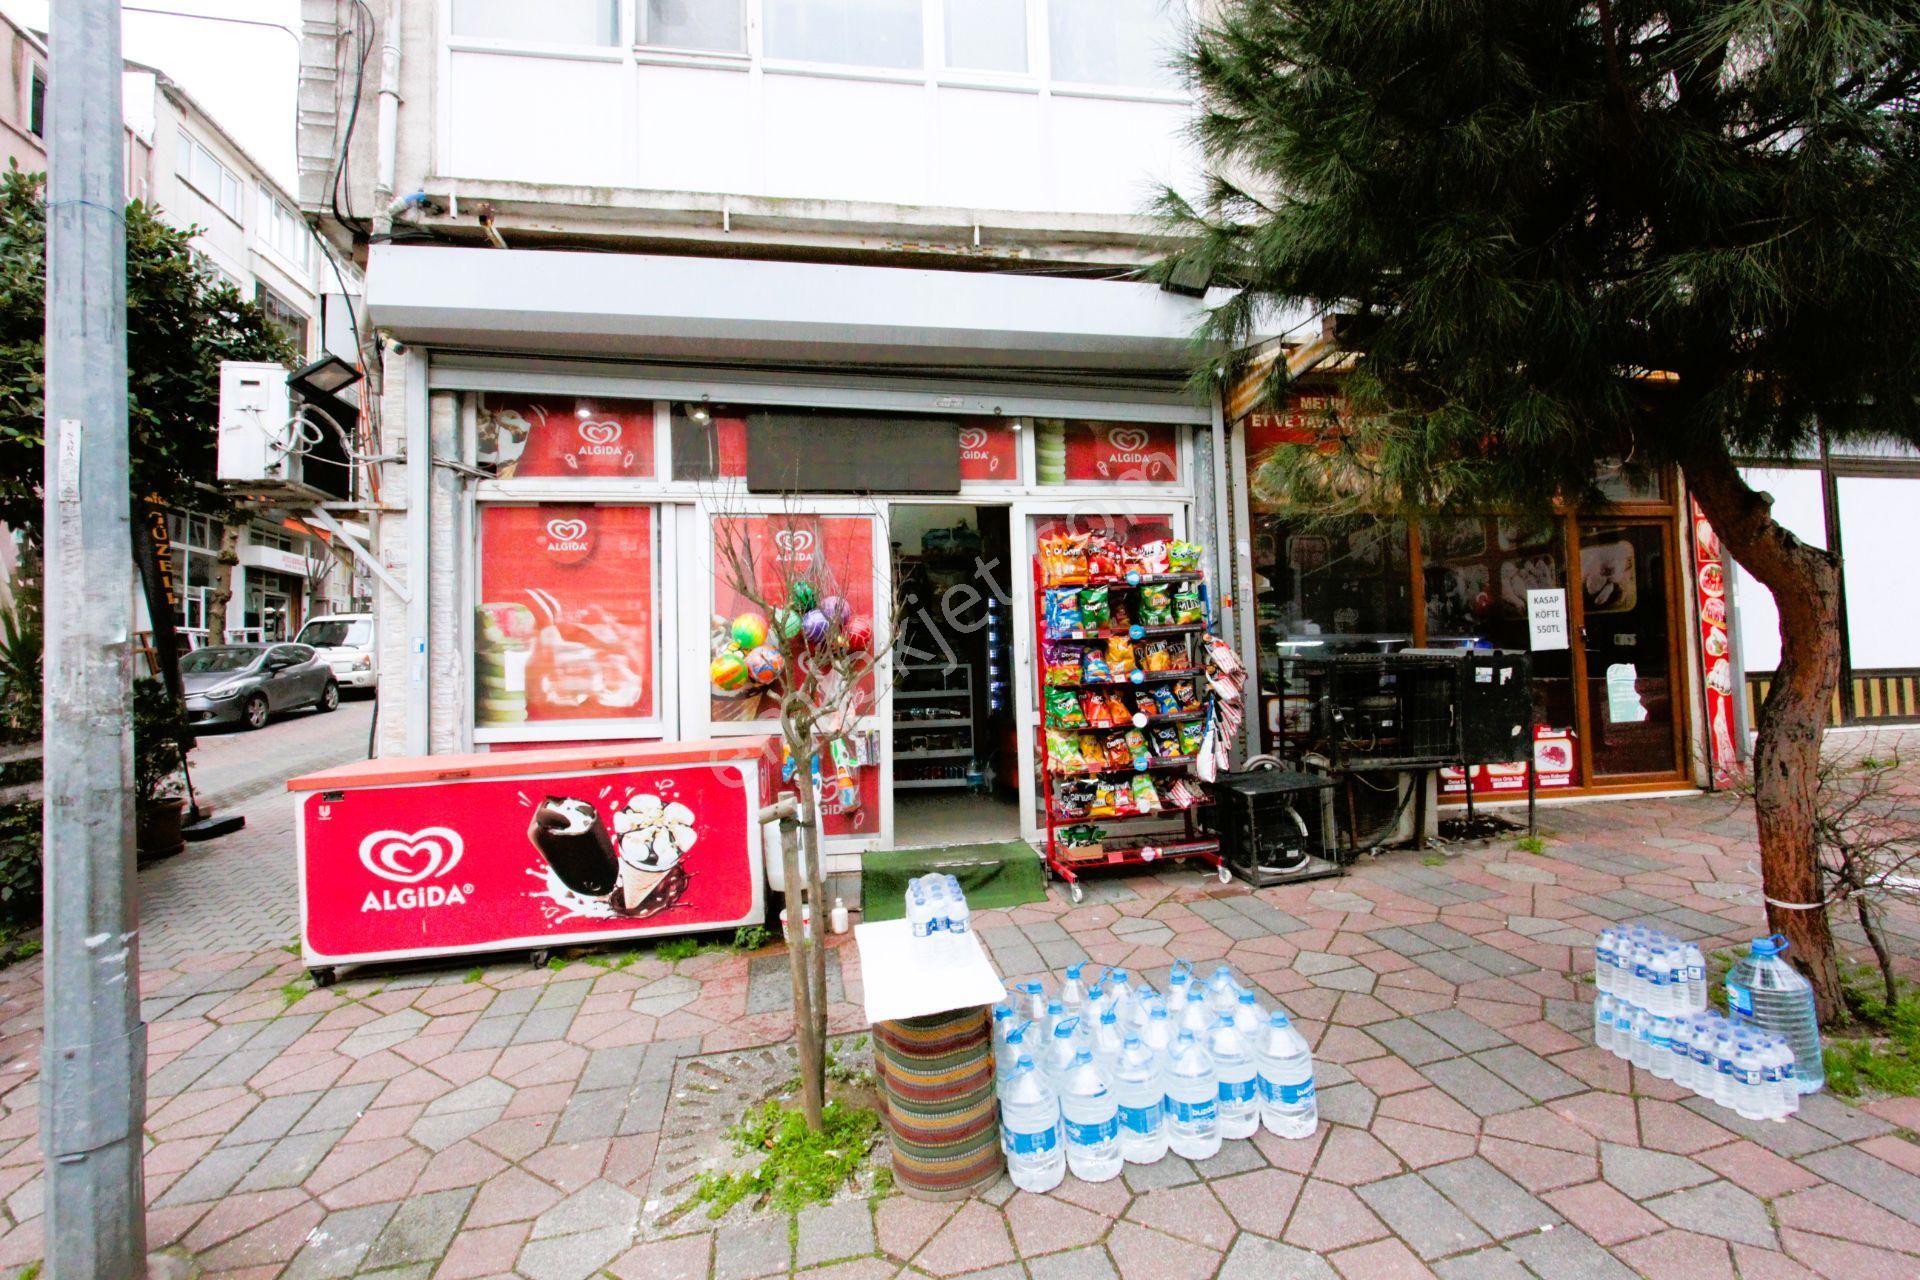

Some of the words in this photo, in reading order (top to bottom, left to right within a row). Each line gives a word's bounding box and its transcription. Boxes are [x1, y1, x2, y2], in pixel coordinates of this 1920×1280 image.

[1252, 414, 1270, 427] ET
[1275, 414, 1294, 428] VE
[960, 451, 986, 460] GIDA
[1533, 596, 1559, 604] KASAP
[1537, 624, 1560, 633] 550TL
